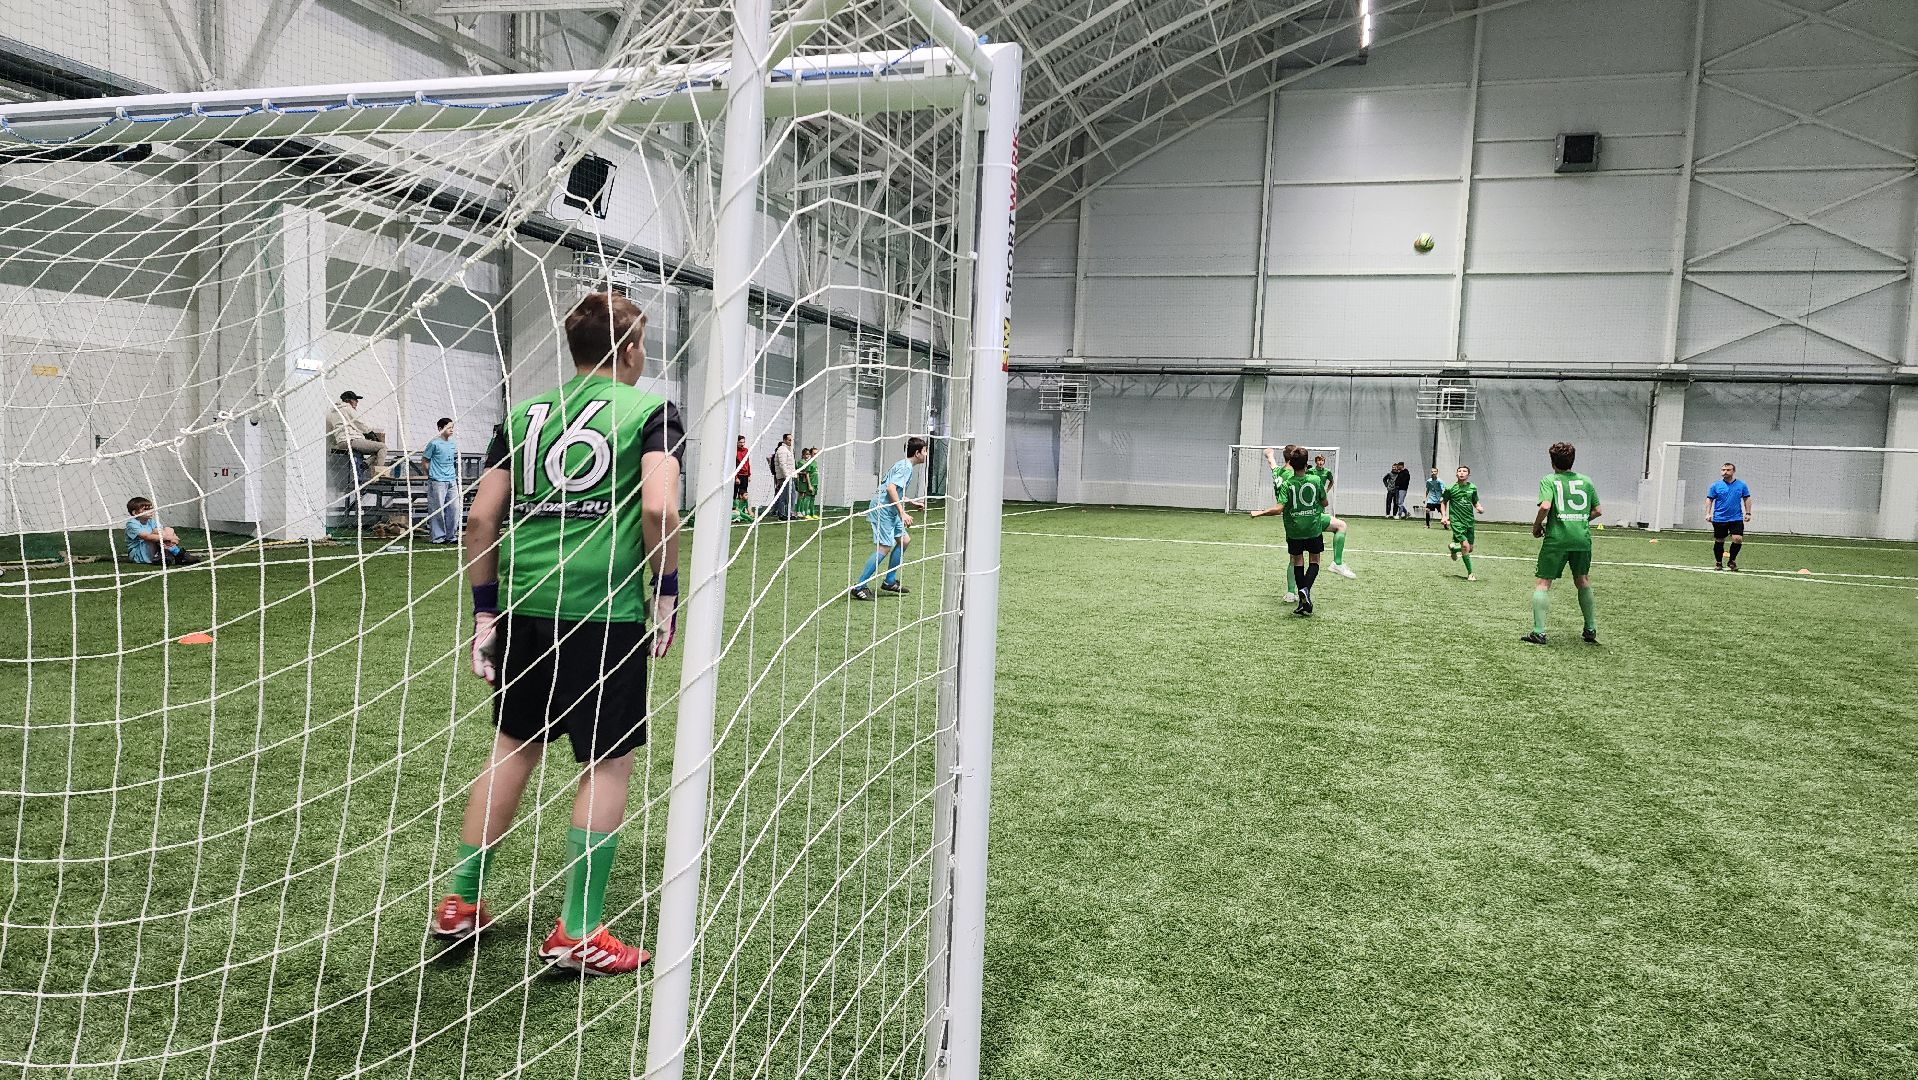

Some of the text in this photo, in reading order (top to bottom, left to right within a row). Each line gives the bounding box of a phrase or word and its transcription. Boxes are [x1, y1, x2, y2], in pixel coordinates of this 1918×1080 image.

[523, 400, 613, 496] 16
[1289, 482, 1316, 509] 10
[1553, 480, 1588, 511] 15
